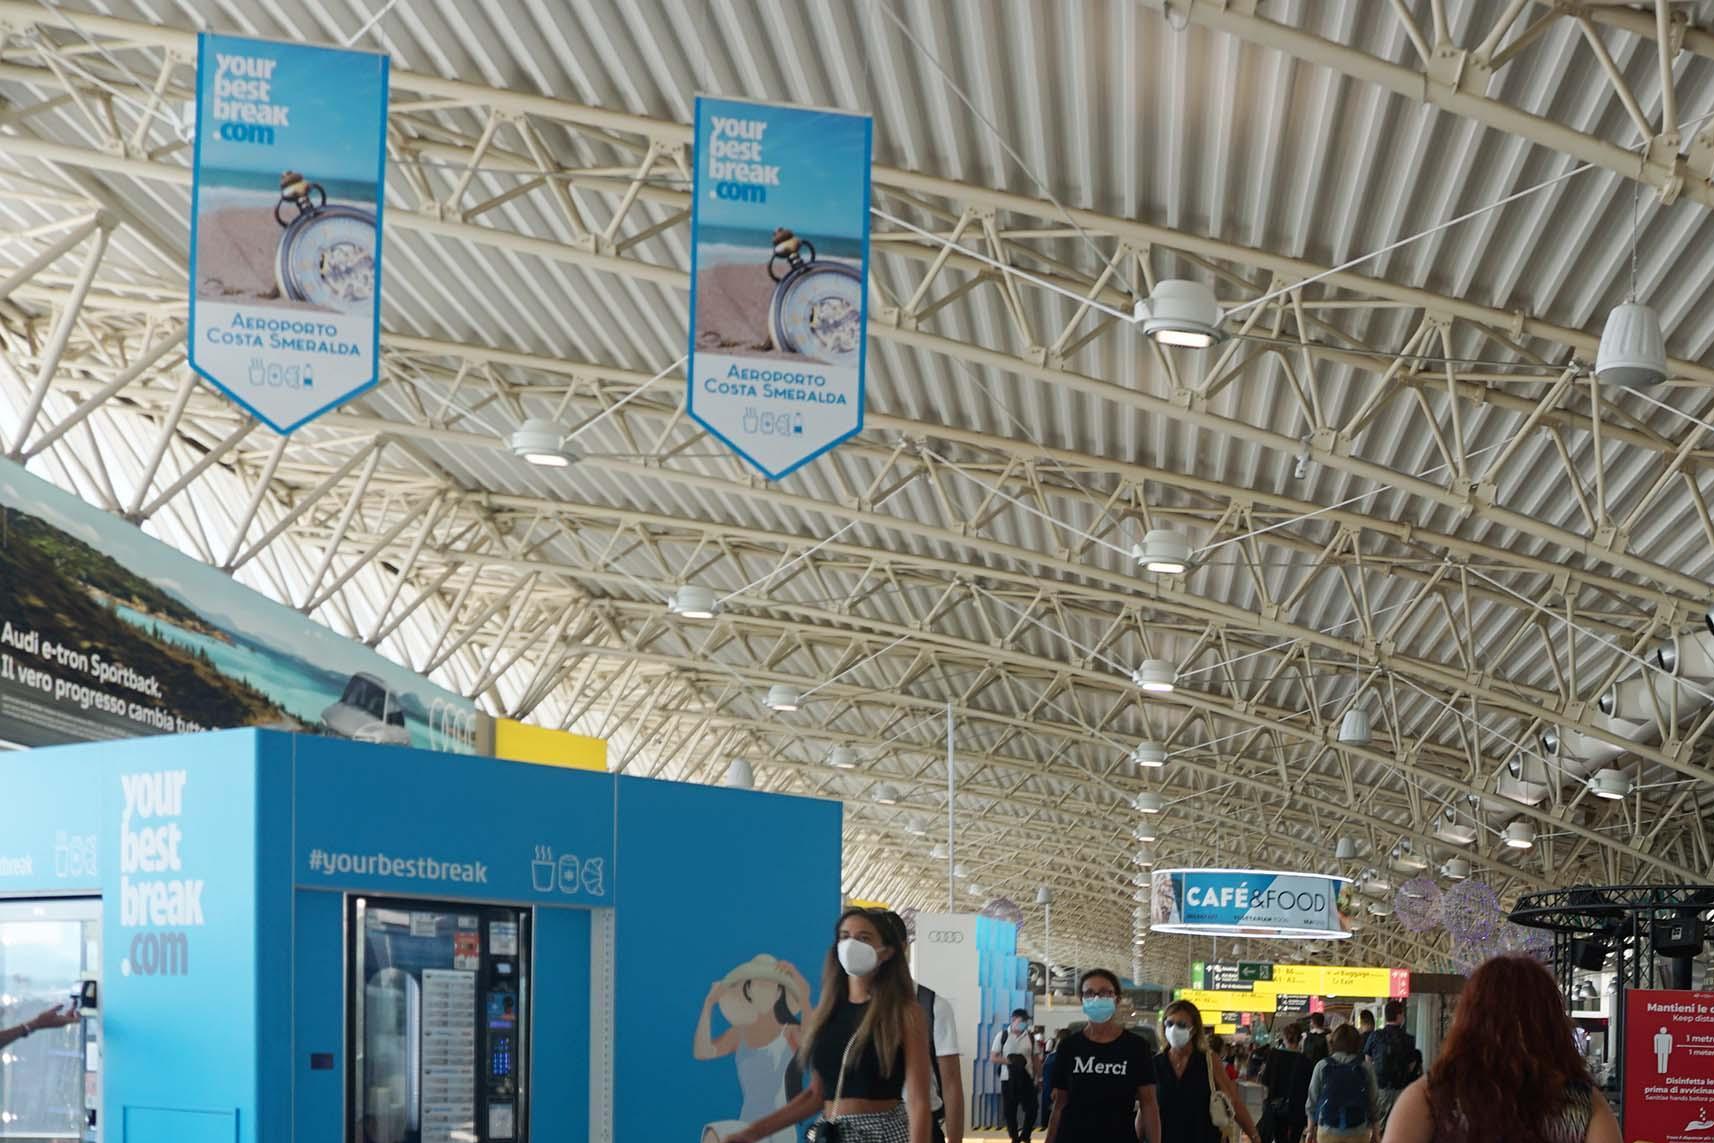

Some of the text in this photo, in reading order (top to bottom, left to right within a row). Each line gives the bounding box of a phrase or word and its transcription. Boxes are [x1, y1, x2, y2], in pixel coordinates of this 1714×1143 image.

[215, 53, 277, 80] your
[214, 75, 271, 102] best
[213, 97, 289, 126] break
[213, 121, 275, 145] .com
[711, 116, 767, 141] your
[709, 136, 762, 161] best
[709, 156, 781, 186] break
[709, 181, 767, 204] .com
[231, 312, 338, 337] AEROPORTO
[206, 327, 361, 357] COSTA SMERALDA
[728, 364, 826, 387] AEROPORTO
[704, 378, 847, 405] COSTA SMERALDA
[1, 621, 162, 698] Audi e-tron Sportback.
[1, 654, 15, 680] Il
[18, 665, 51, 692] vero
[55, 677, 126, 716] progresso
[128, 702, 173, 731] cambia
[120, 769, 187, 822] your
[120, 820, 183, 873] best
[309, 848, 488, 883] #yourbestbreak
[120, 875, 205, 927] break
[120, 931, 189, 976] .com
[1648, 1003, 1695, 1013] Mantieni
[1698, 1004, 1708, 1013] le
[1673, 1015, 1693, 1023] Keep
[1072, 1056, 1128, 1075] Merci
[1645, 1086, 1668, 1095] prima
